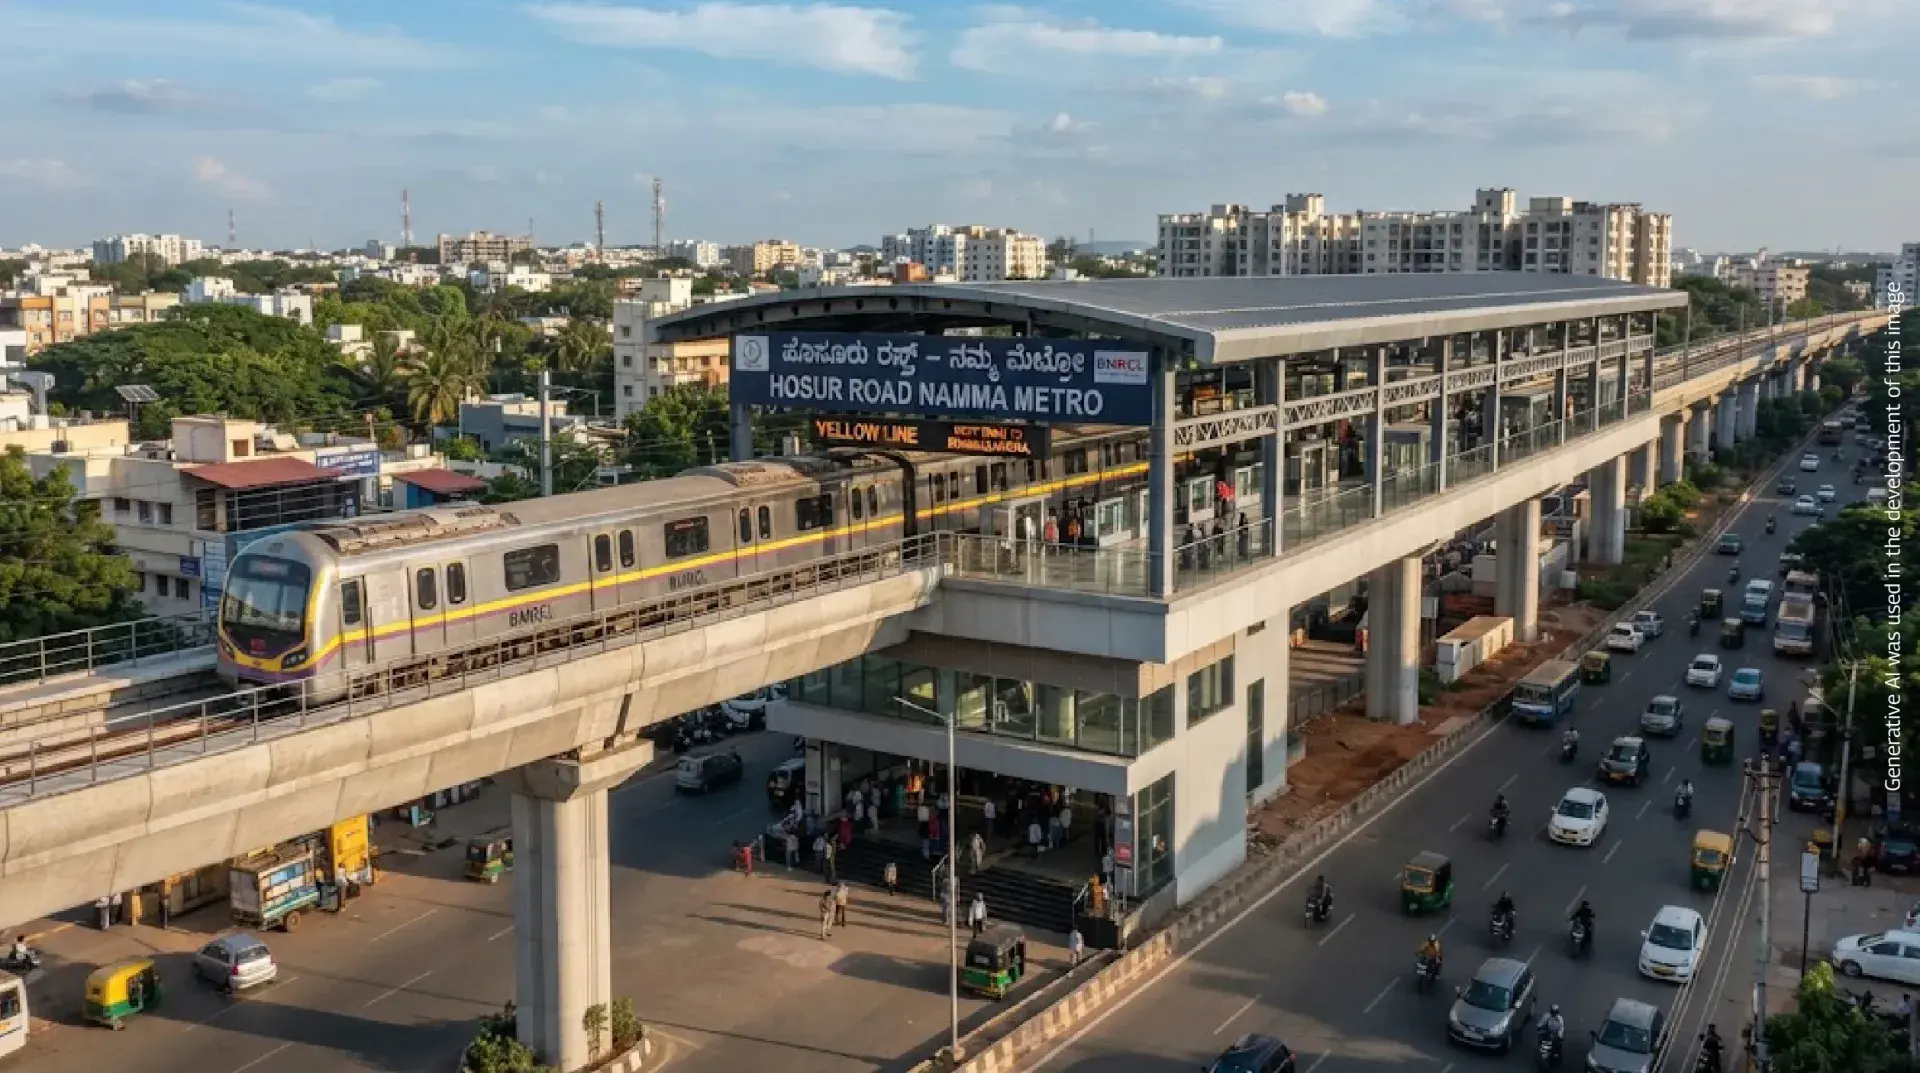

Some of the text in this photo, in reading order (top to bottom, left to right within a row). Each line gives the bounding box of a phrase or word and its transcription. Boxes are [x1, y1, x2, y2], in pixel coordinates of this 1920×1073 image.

[769, 374, 1104, 416] HOSUR ROAD NAMMA METRO
[816, 420, 919, 444] YELLOW LINE
